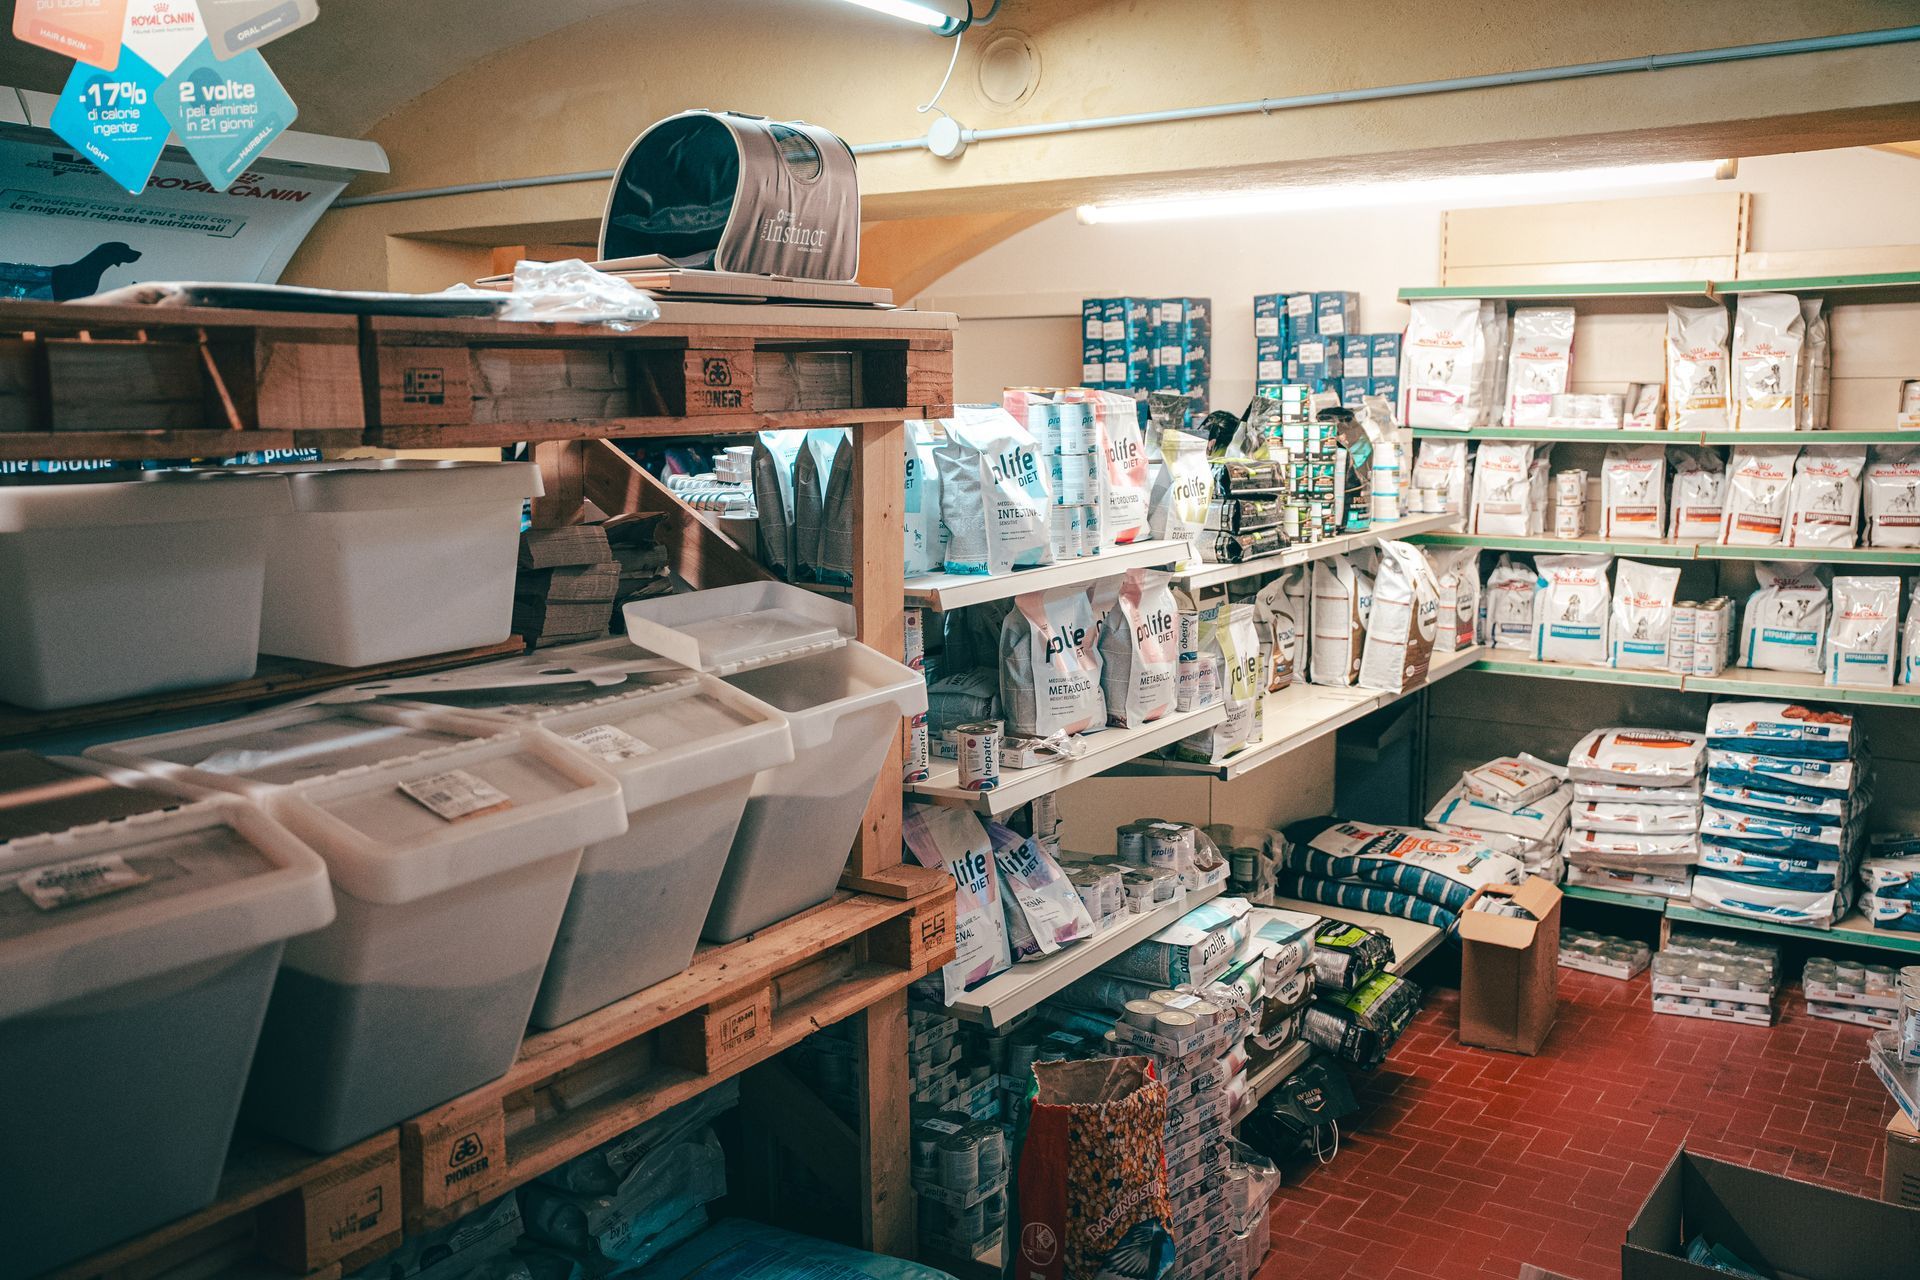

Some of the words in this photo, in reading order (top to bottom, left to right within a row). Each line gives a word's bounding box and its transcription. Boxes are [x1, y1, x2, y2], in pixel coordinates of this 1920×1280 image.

[131, 14, 160, 27] ROYAL
[163, 12, 195, 25] CANIN
[40, 29, 60, 40] HAIR
[66, 37, 87, 50] SKIN
[237, 26, 259, 41] ORAL
[179, 82, 195, 102] 2
[202, 80, 256, 101] volte
[88, 109, 98, 121] di
[102, 107, 140, 120] calorie
[186, 104, 206, 119] peli
[210, 102, 258, 117] eliminati
[187, 119, 197, 131] in
[201, 118, 216, 132] 21
[86, 142, 110, 162] LIGHT
[239, 126, 273, 159] HAIRBALL
[228, 185, 312, 203] CANIN
[9, 201, 26, 211] le
[27, 203, 88, 218] migliori
[89, 210, 148, 224] risposte
[149, 218, 227, 233] nutrizionali
[16, 194, 88, 209] Prendersi
[89, 202, 120, 213] cura
[124, 205, 137, 215] di
[139, 207, 167, 218] cani
[179, 212, 209, 223] gatti
[211, 216, 232, 225] con
[765, 218, 827, 247] Instinct
[1123, 458, 1139, 470] DIET
[1018, 471, 1038, 487] DIET
[1158, 631, 1174, 644] DIET
[1181, 617, 1189, 649] obesity
[1763, 630, 1814, 641] HYPOALLERGENIC
[1049, 680, 1091, 696] METABOLIC
[1140, 672, 1170, 686] METABOLIC
[919, 728, 927, 768] hepatic
[983, 735, 992, 777] hepatic
[1151, 847, 1175, 858] prolife
[1021, 857, 1039, 878] DIET
[970, 874, 990, 894] DIET
[1203, 932, 1227, 966] prolife
[1275, 944, 1298, 975] prolife
[1132, 1033, 1156, 1046] prolife
[445, 1155, 489, 1187] PIONEER
[1086, 1190, 1139, 1241] RACING
